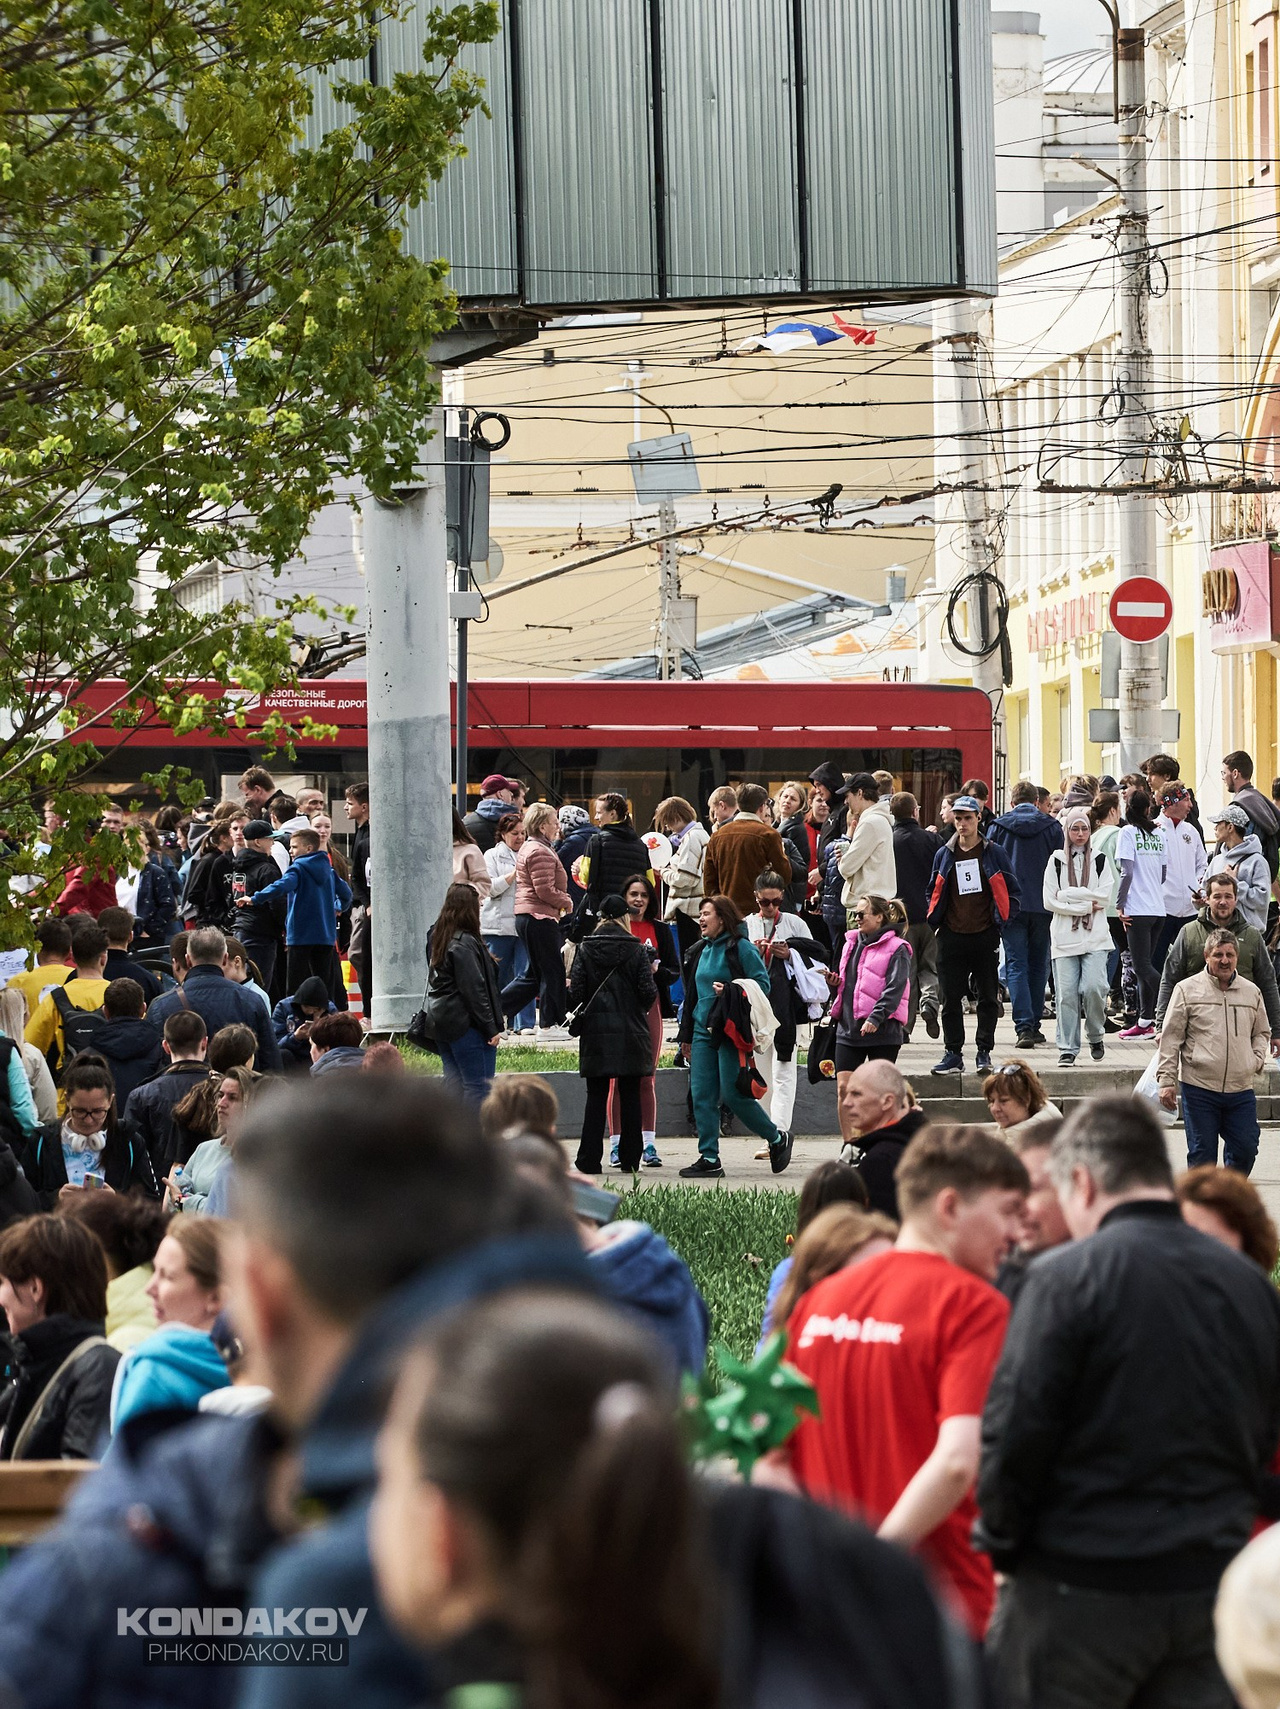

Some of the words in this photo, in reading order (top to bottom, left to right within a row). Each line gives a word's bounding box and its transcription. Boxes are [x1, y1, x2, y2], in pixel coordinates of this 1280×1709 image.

[265, 689, 326, 698] ЕЗОПАСНЫЕ
[264, 699, 335, 708] КАЧЕСТВЕННЫЕ
[337, 700, 367, 709] ДОРОГ
[1136, 842, 1164, 852] POWE
[965, 871, 972, 882] 5
